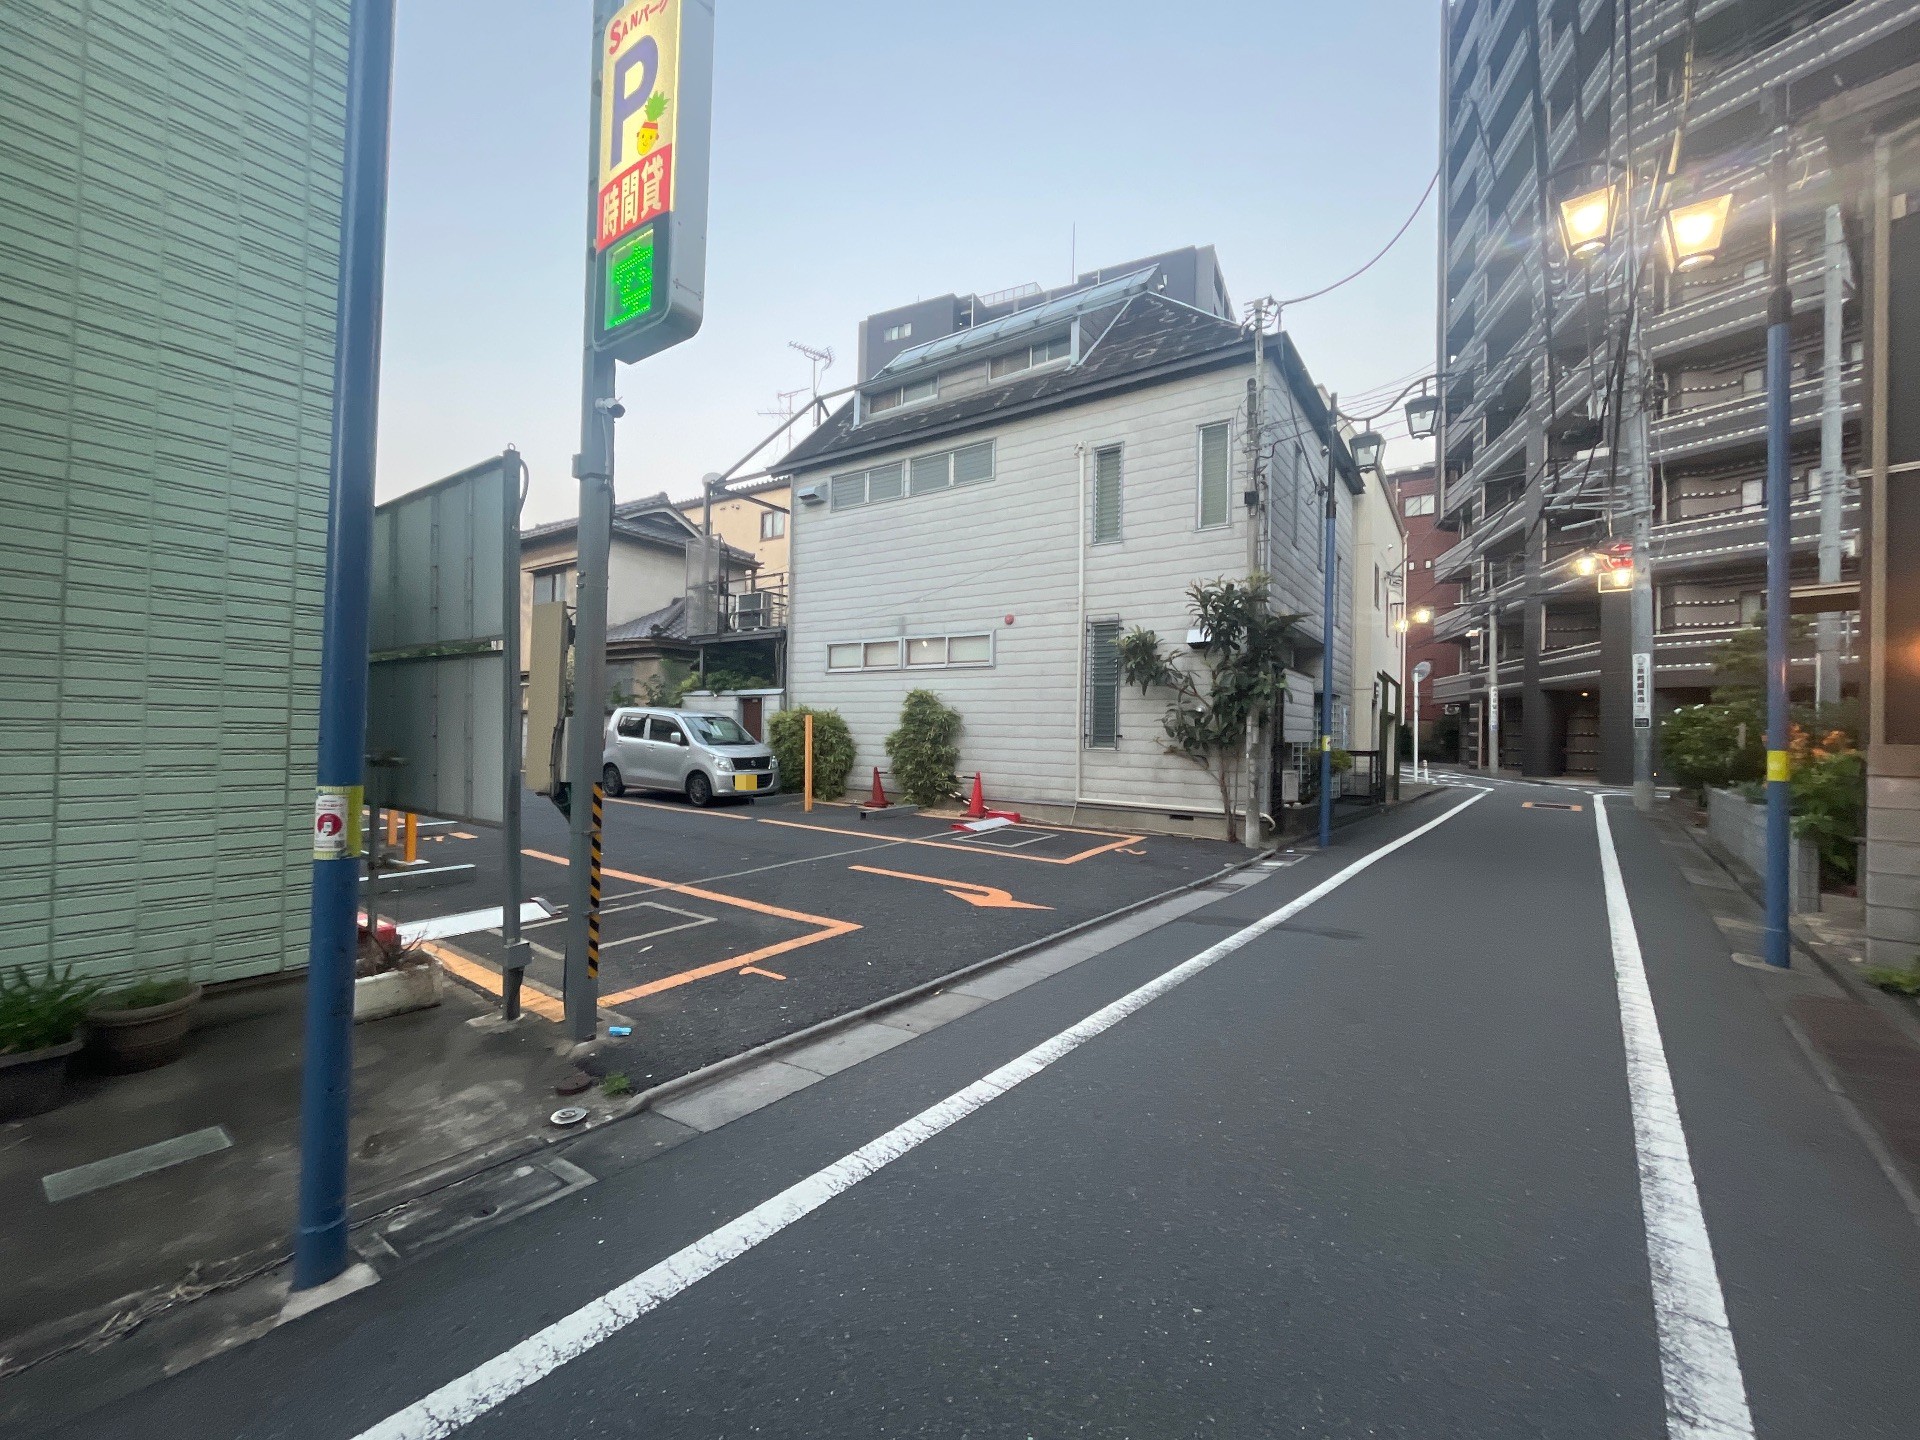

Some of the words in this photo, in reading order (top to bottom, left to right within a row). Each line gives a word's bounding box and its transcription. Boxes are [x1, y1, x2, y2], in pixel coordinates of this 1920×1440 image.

[610, 35, 659, 172] P
[602, 154, 664, 240] 時間貸
[615, 244, 652, 326] 空
